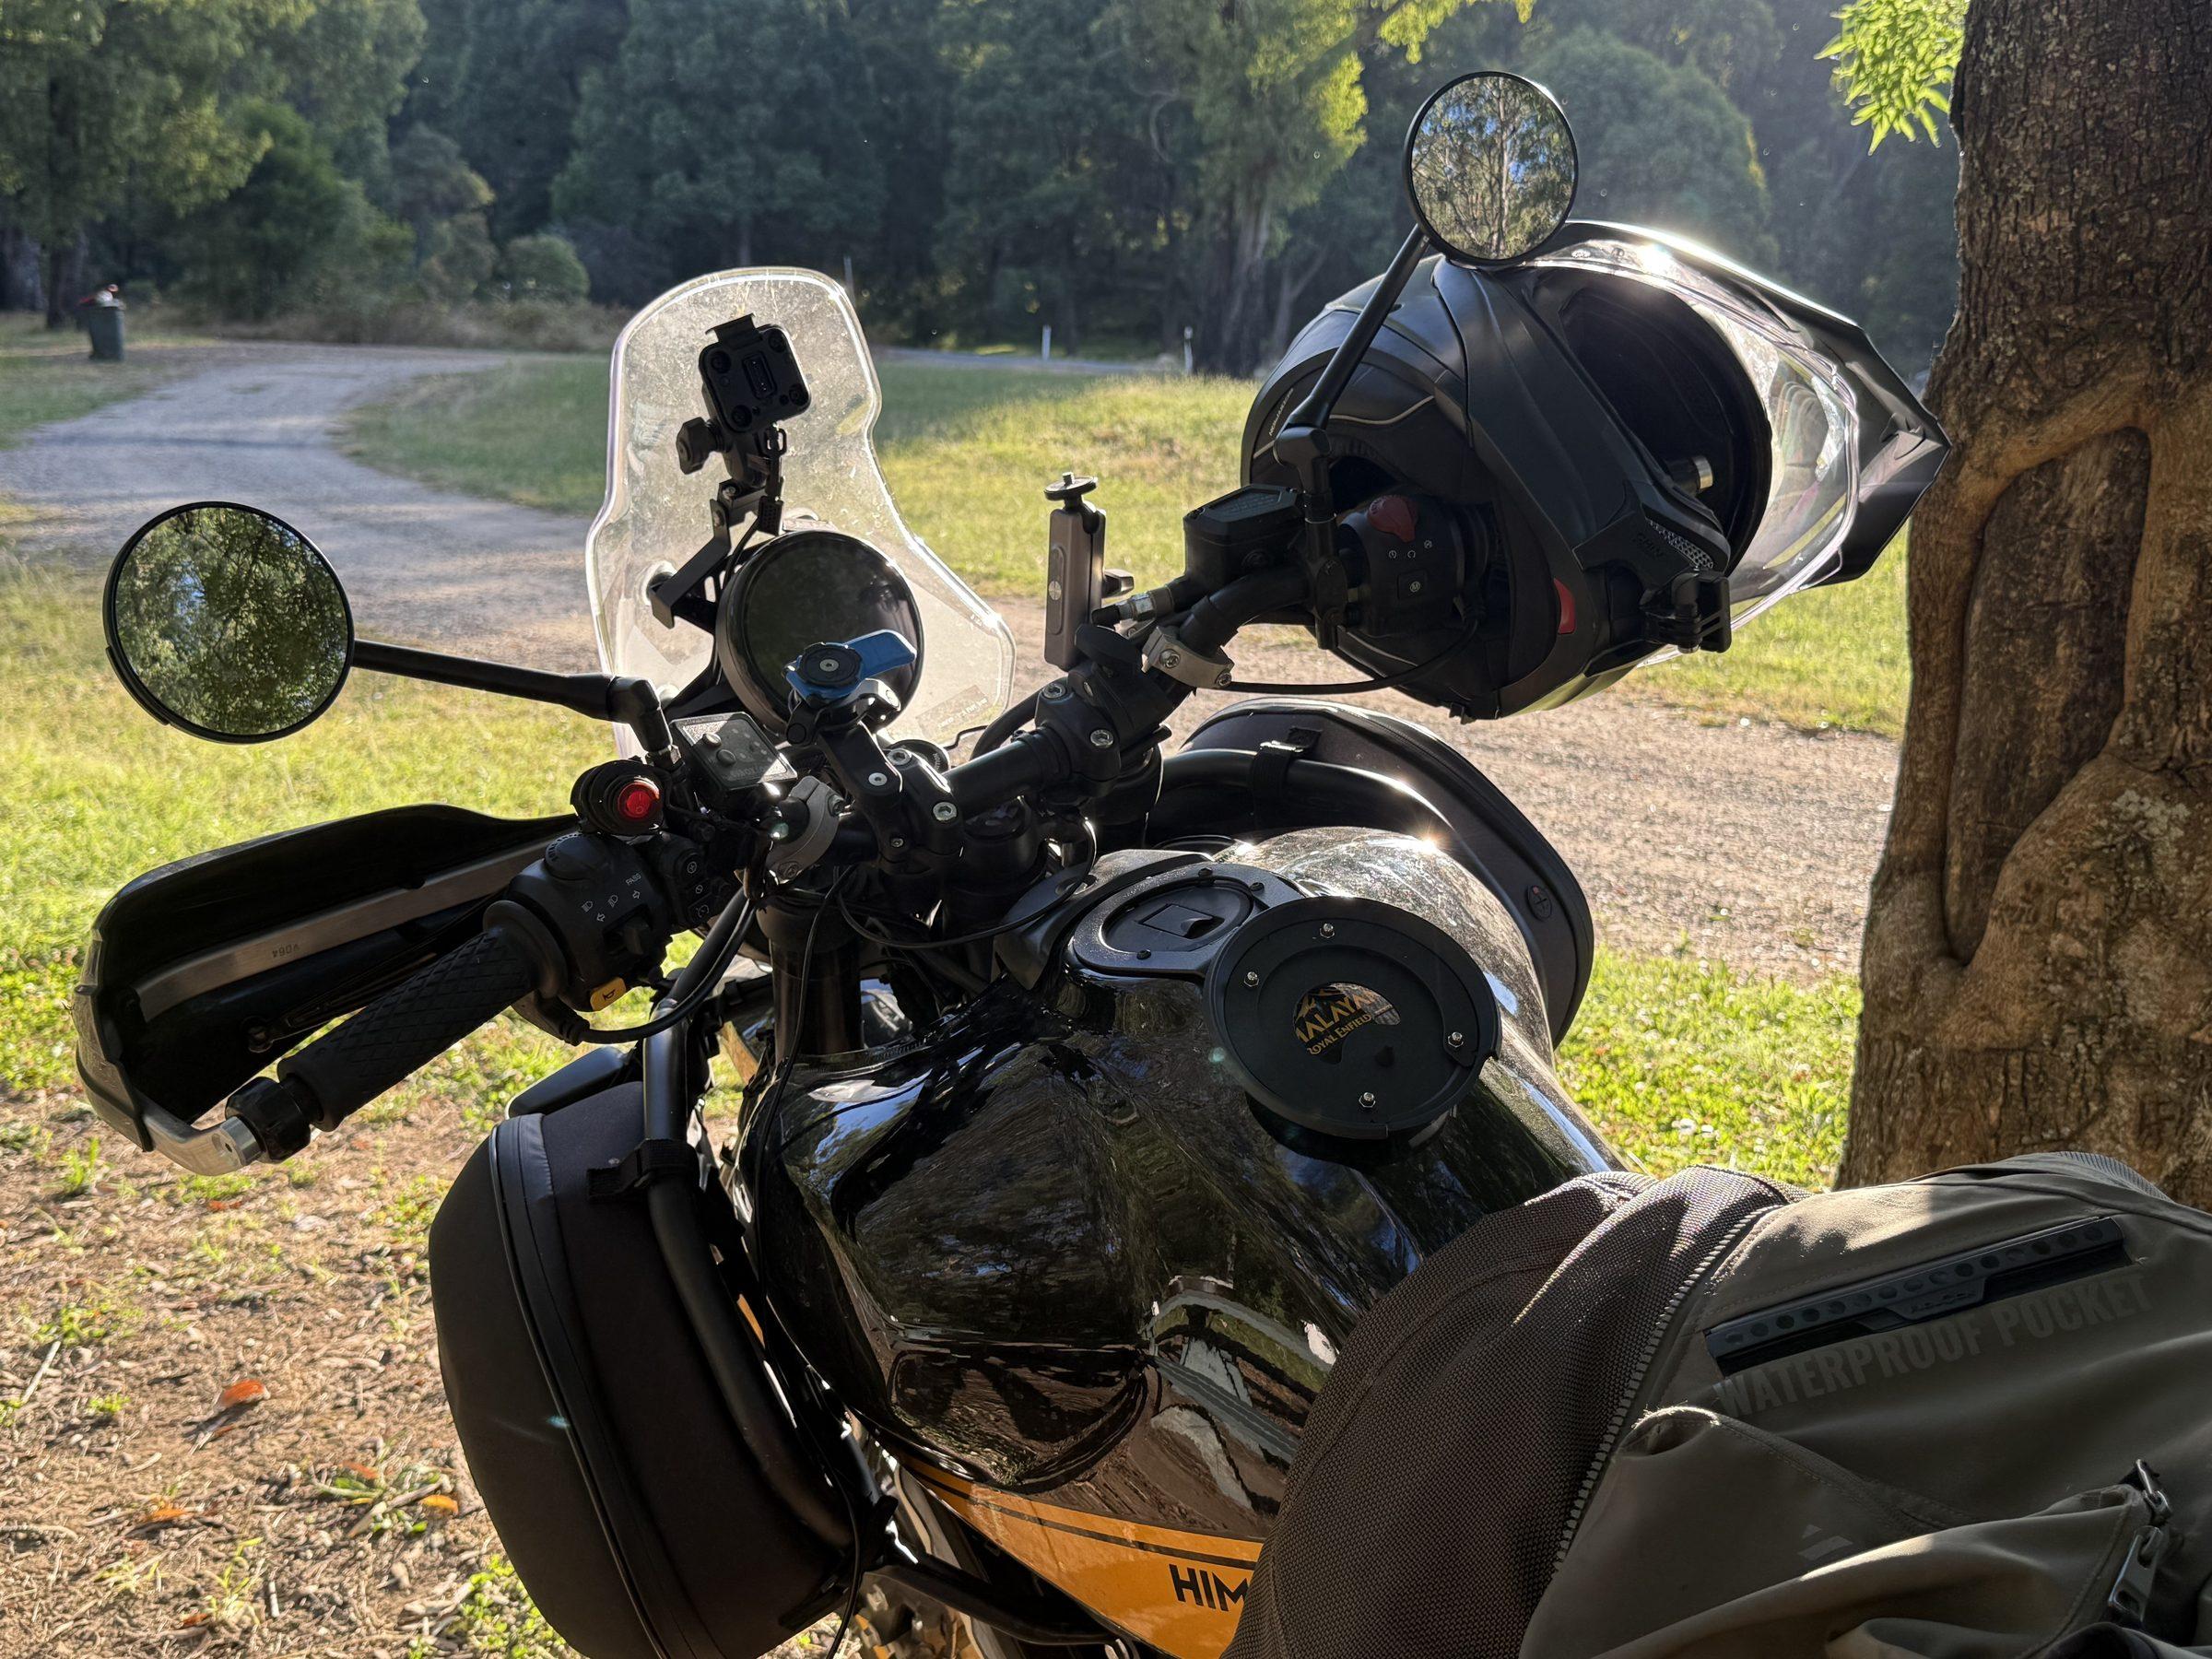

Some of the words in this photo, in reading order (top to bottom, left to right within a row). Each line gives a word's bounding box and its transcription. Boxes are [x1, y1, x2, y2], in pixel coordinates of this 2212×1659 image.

[625, 872, 642, 886] PASS
[1712, 1316, 1983, 1418] WATERPROOF
[1991, 1274, 2153, 1348] POCKET
